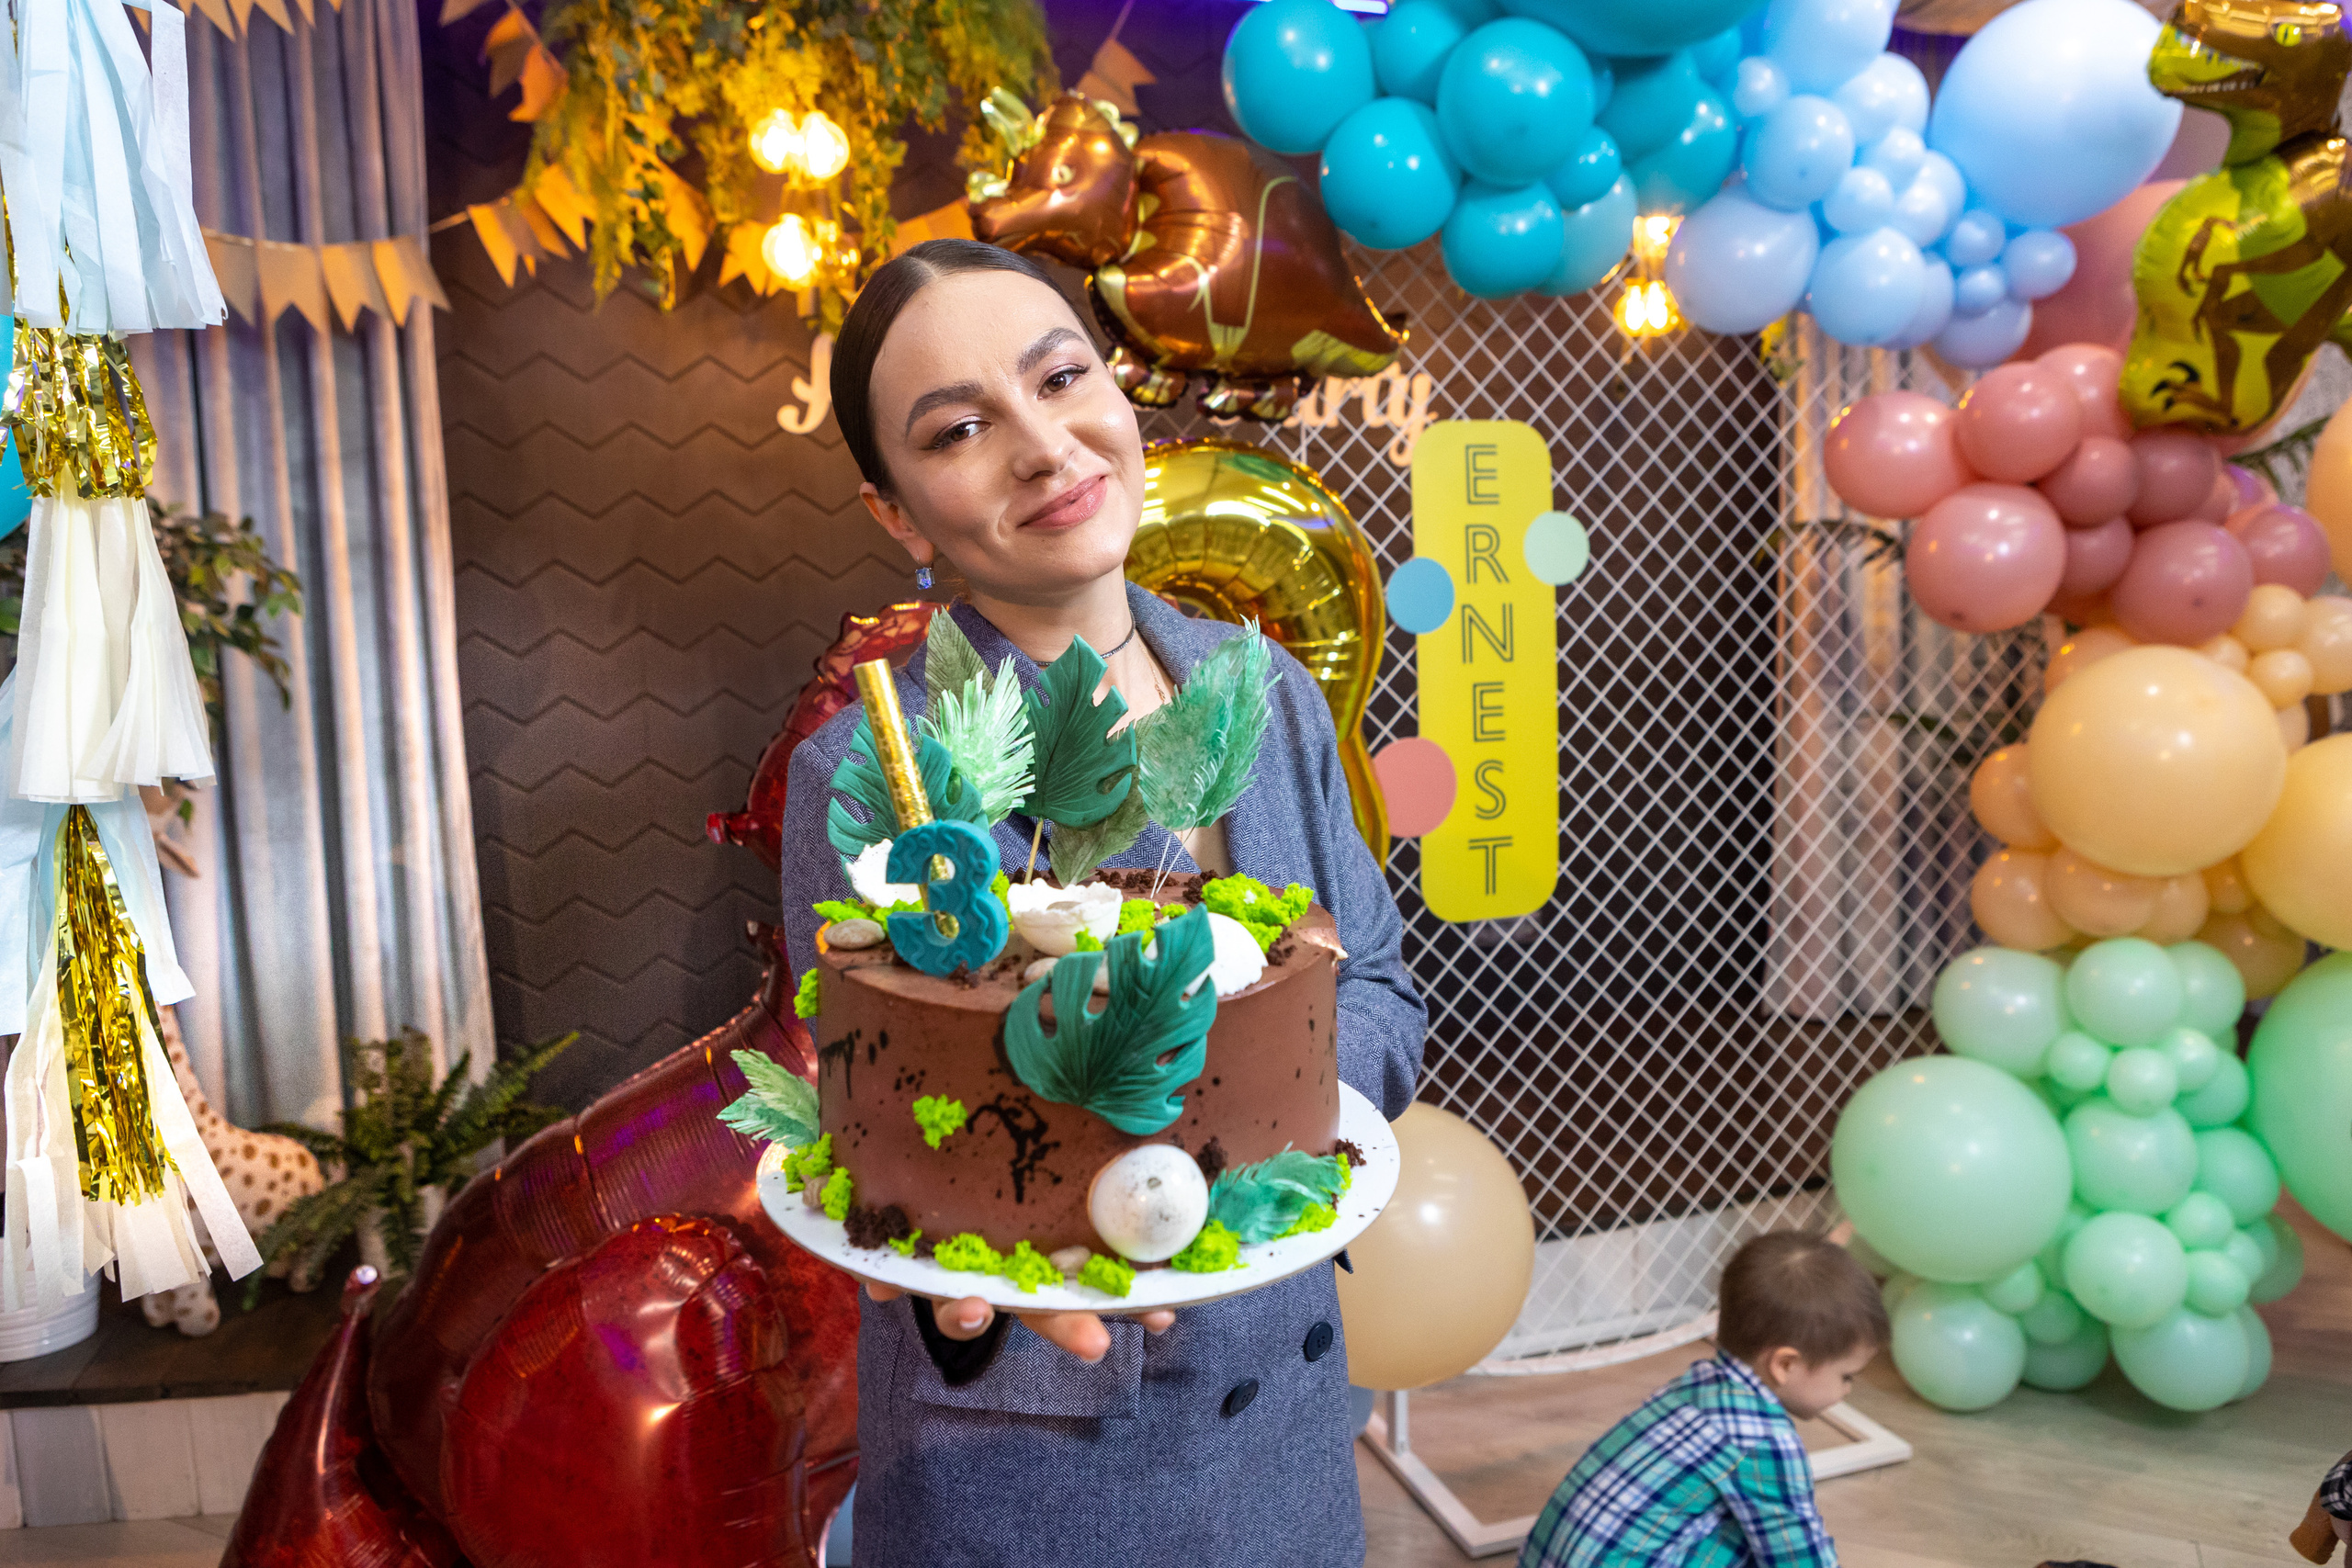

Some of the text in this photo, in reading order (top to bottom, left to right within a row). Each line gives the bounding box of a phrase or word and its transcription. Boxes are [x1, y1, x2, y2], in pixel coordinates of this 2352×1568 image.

[1281, 361, 1439, 468] arty
[1461, 443, 1515, 897] ERNEST
[886, 819, 1009, 978] 3
